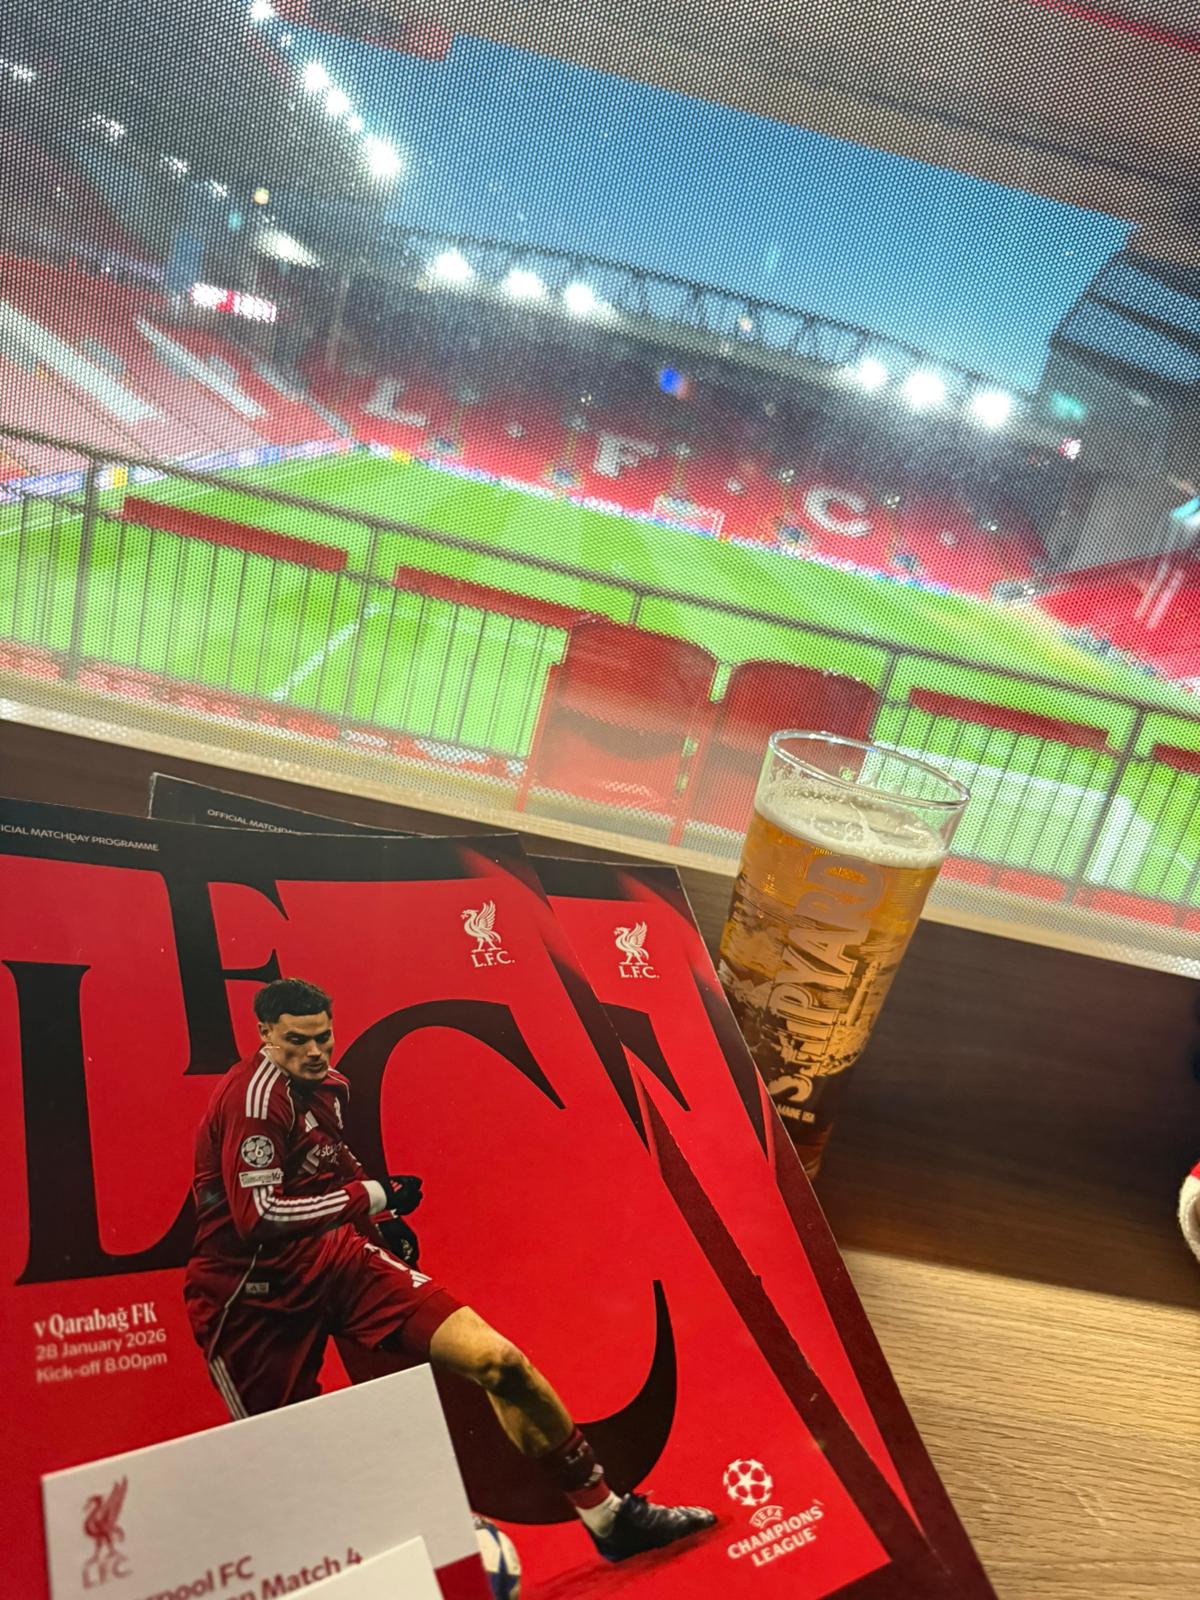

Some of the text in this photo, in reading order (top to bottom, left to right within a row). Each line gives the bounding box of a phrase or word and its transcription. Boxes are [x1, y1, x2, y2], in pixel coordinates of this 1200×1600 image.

[207, 809, 248, 825] OFFICIAL
[0, 824, 160, 851] ICIAL MATCHDAY PROGRAMME
[471, 950, 515, 968] L.F.C.
[618, 965, 660, 979] L.F.C.
[767, 855, 886, 1101] SHIPYARD
[34, 1302, 157, 1340] v Qarabağ FK
[36, 1328, 167, 1361] 28 January 2026
[36, 1352, 168, 1383] Kick-off 8.00pm
[752, 1508, 782, 1527] UEFA
[751, 1527, 817, 1567] LEAGUE
[219, 1555, 255, 1588] FC
[259, 1547, 364, 1600] Match 4
